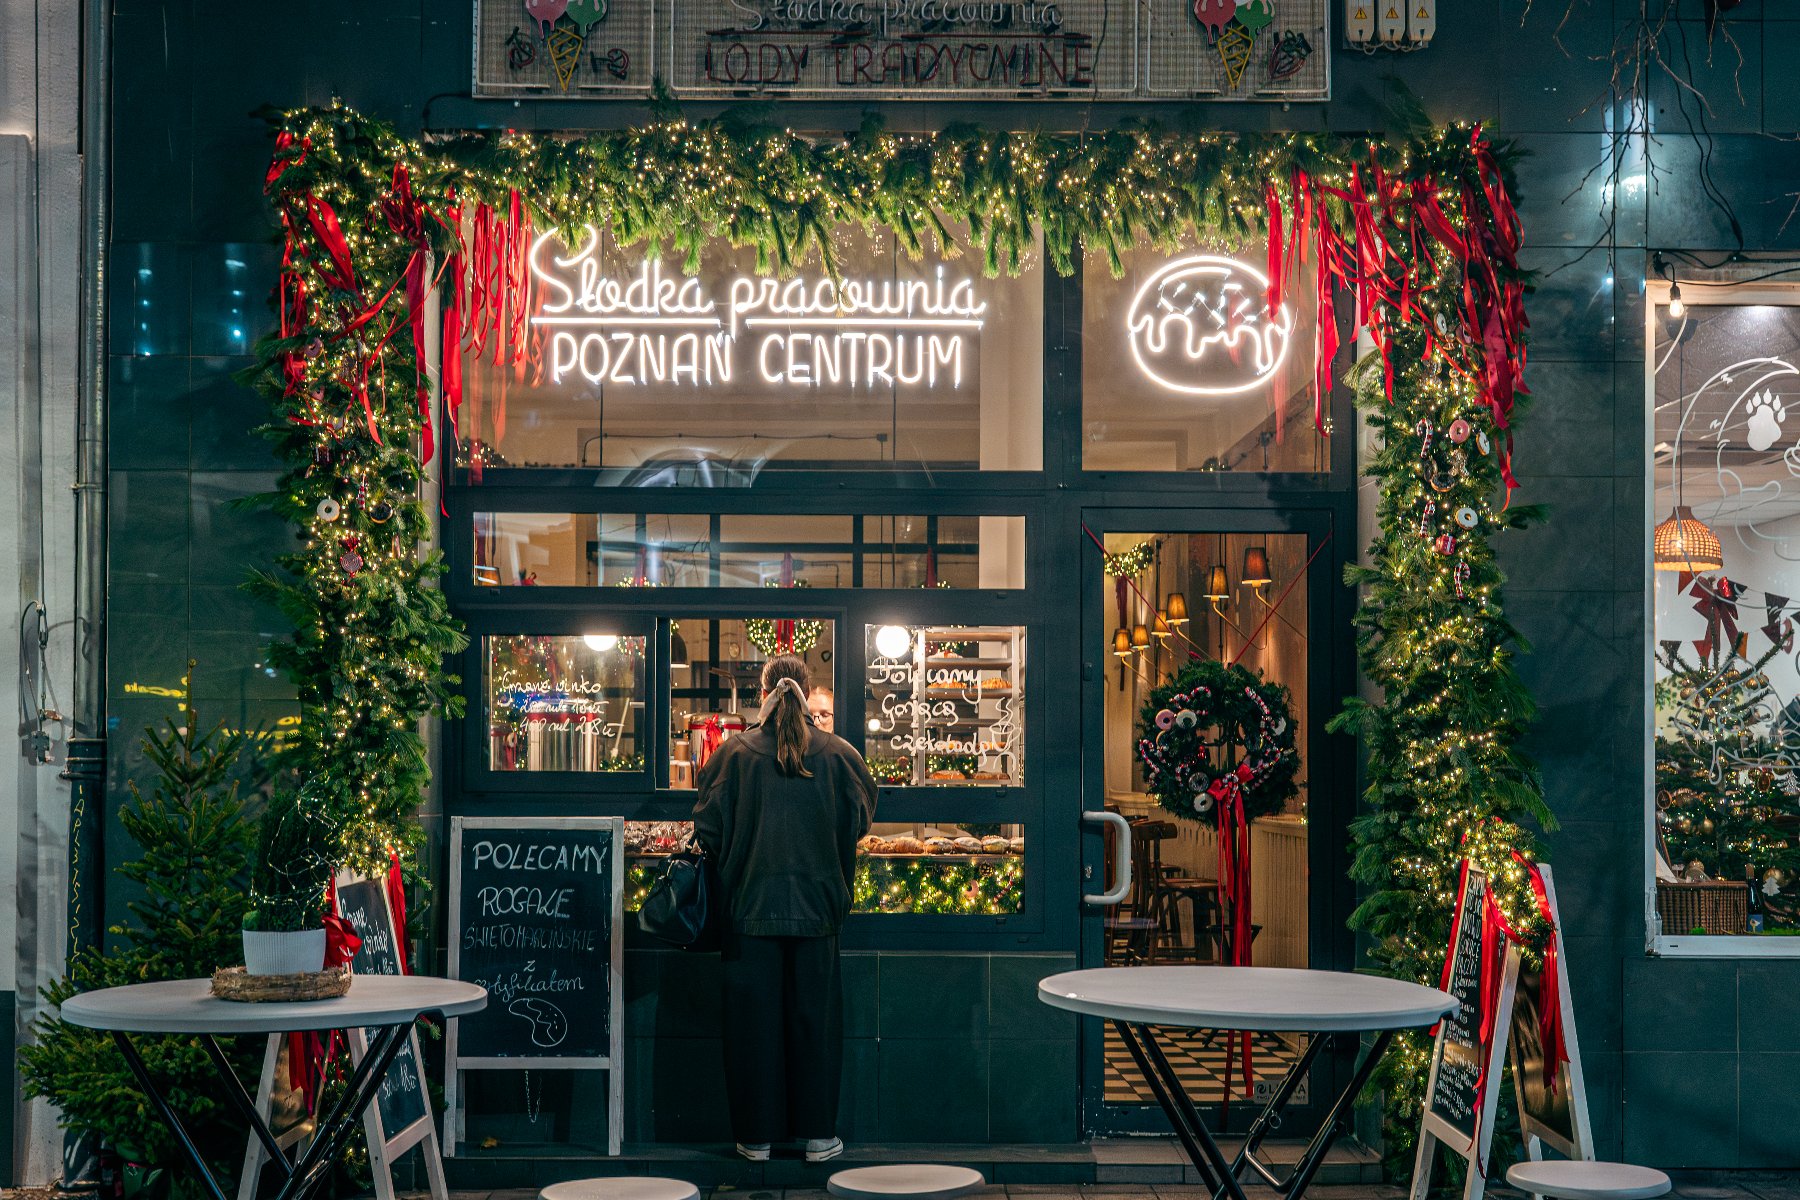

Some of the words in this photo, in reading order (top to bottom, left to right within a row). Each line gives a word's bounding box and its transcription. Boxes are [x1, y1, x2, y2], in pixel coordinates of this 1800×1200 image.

[706, 43, 809, 84] LODY
[529, 223, 714, 313] Słodka
[730, 265, 987, 343] pracownia
[553, 330, 731, 385] POZNAŃ
[760, 333, 962, 388] CENTRUM
[473, 840, 607, 875] POLECAMY
[478, 886, 575, 918] ROGALE
